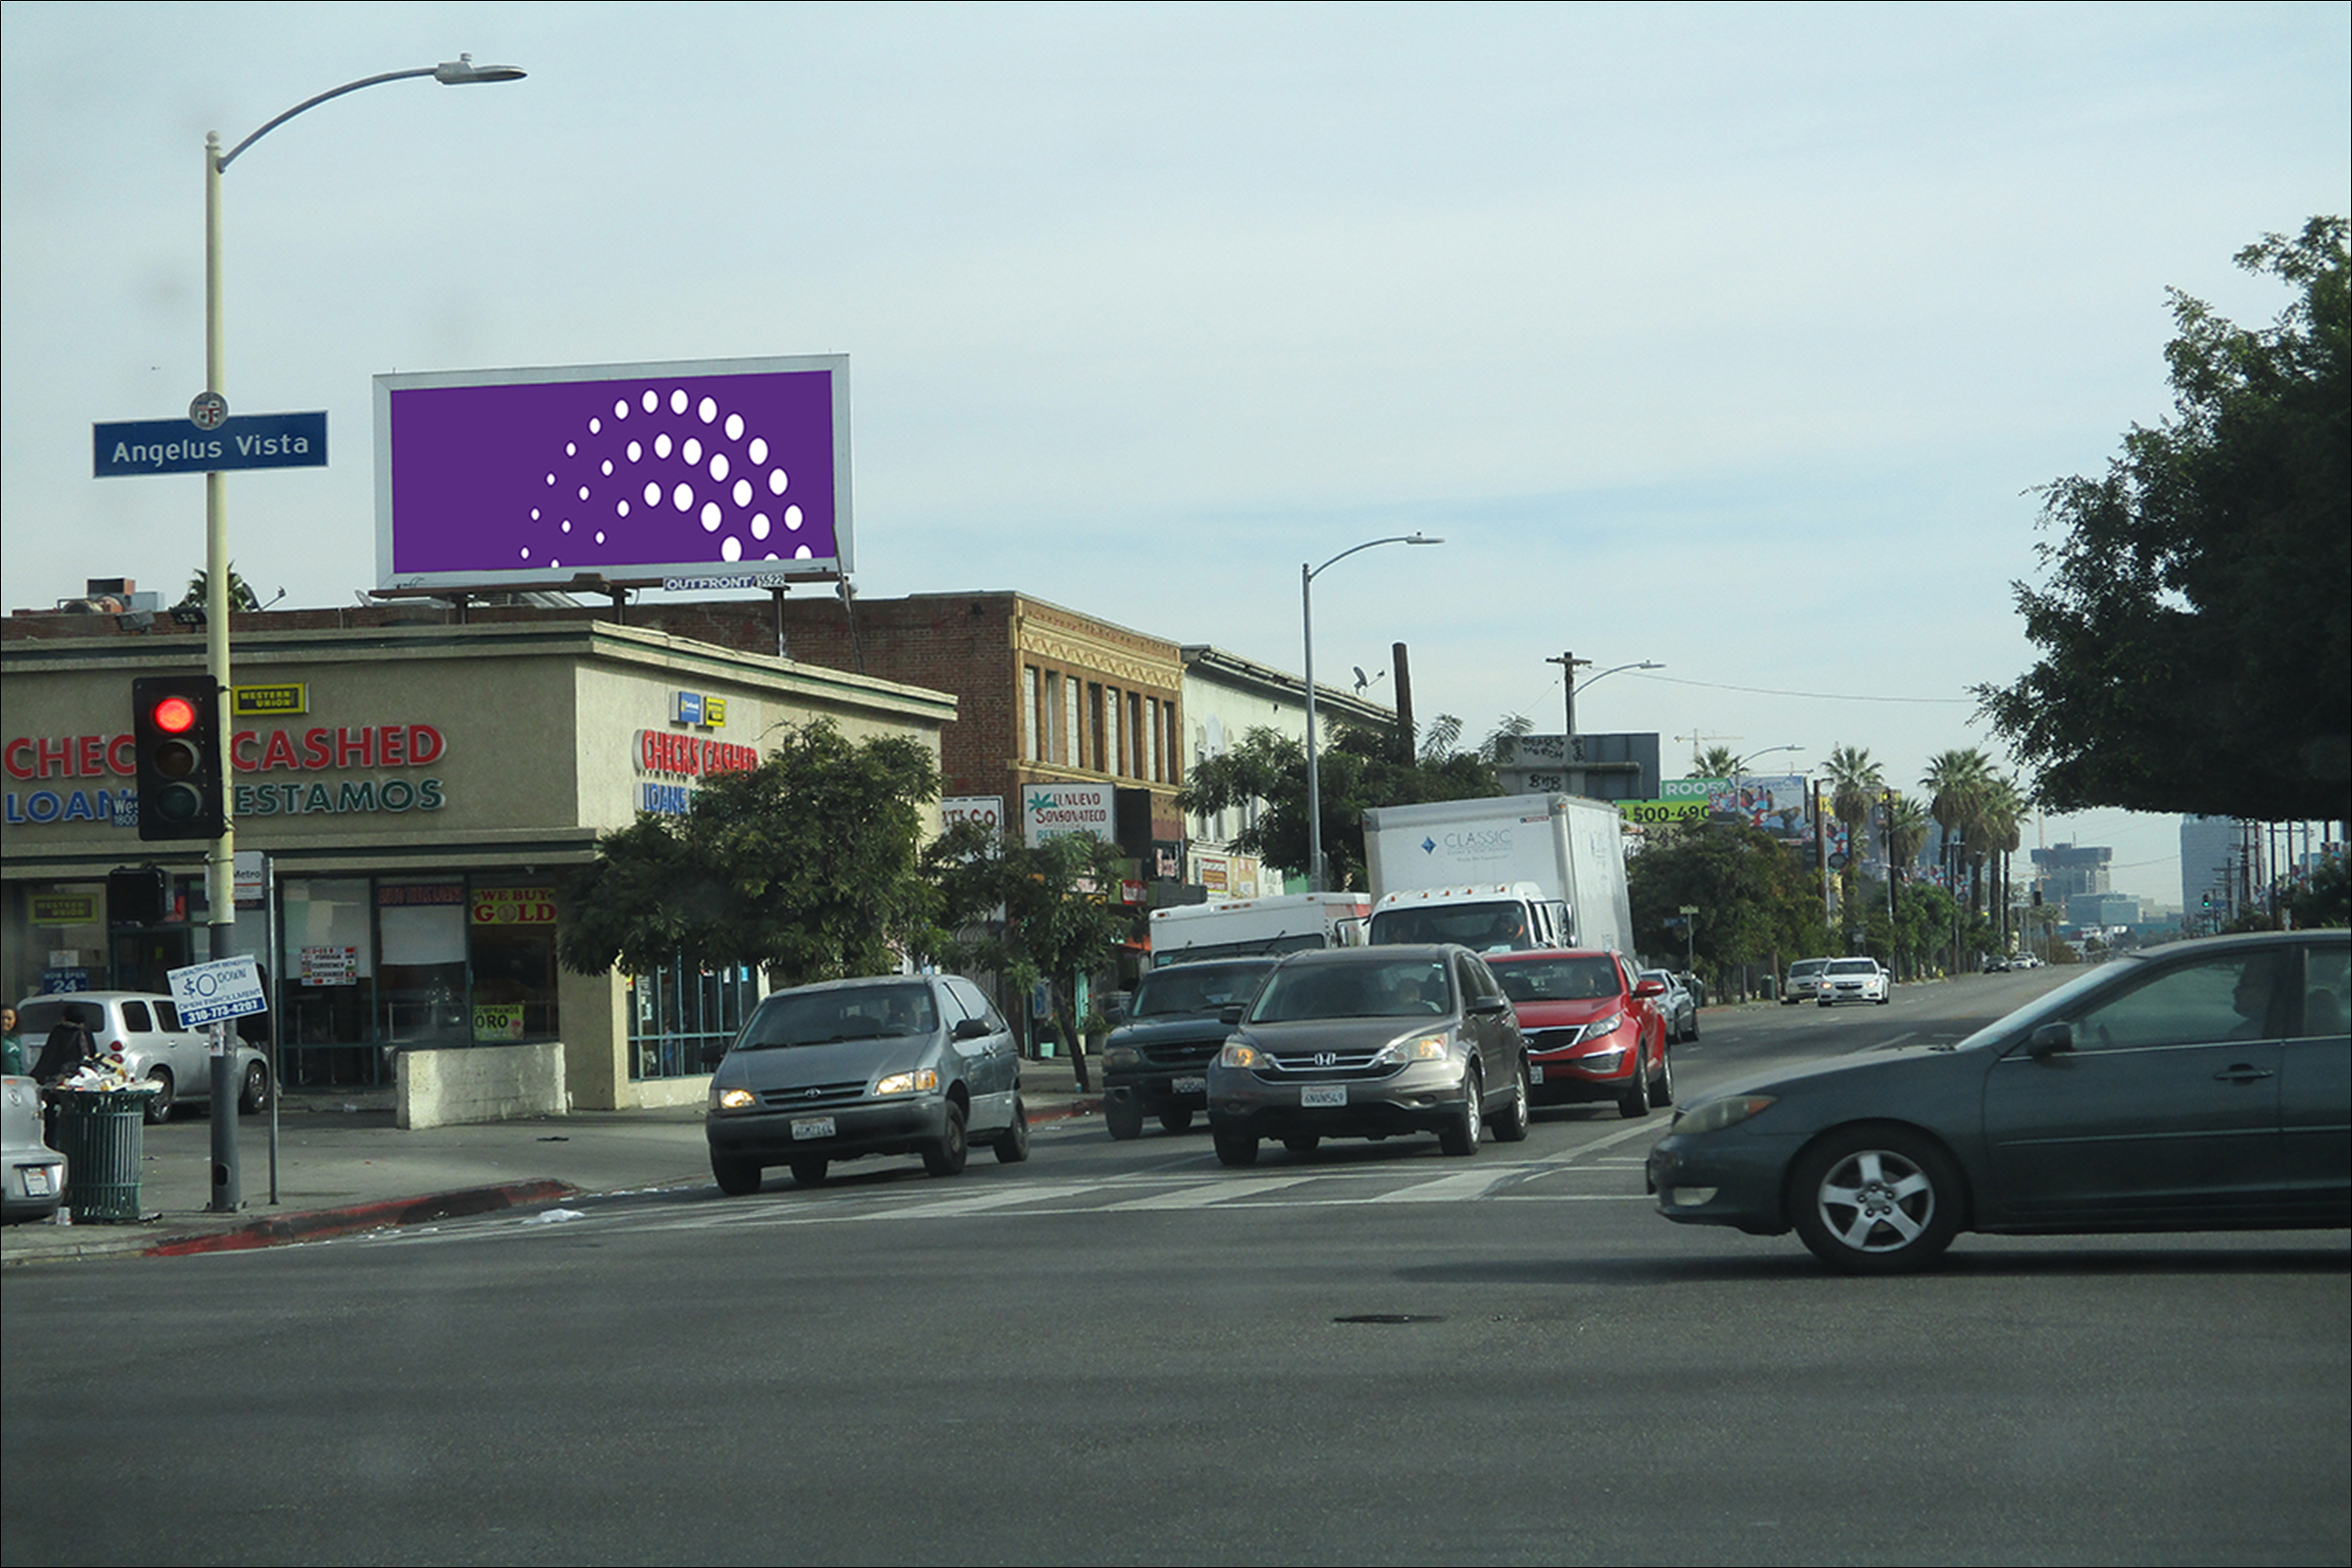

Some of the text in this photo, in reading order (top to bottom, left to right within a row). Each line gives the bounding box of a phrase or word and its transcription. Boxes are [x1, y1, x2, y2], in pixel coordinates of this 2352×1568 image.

[112, 434, 309, 467] Angelus Vista
[240, 691, 291, 701] WESTERN
[256, 699, 291, 708] UNION
[4, 724, 447, 779] CHEC CASHED
[642, 730, 700, 776] CHECKS
[6, 780, 445, 824] LOAN ESTAMOS
[114, 799, 139, 813] Wes
[643, 783, 686, 814] LOANS
[1064, 793, 1101, 806] NUEVO
[1444, 829, 1512, 848] CLASSIC
[480, 889, 549, 901] WE BUY
[53, 980, 77, 993] 24
[475, 1014, 509, 1029] ORO
